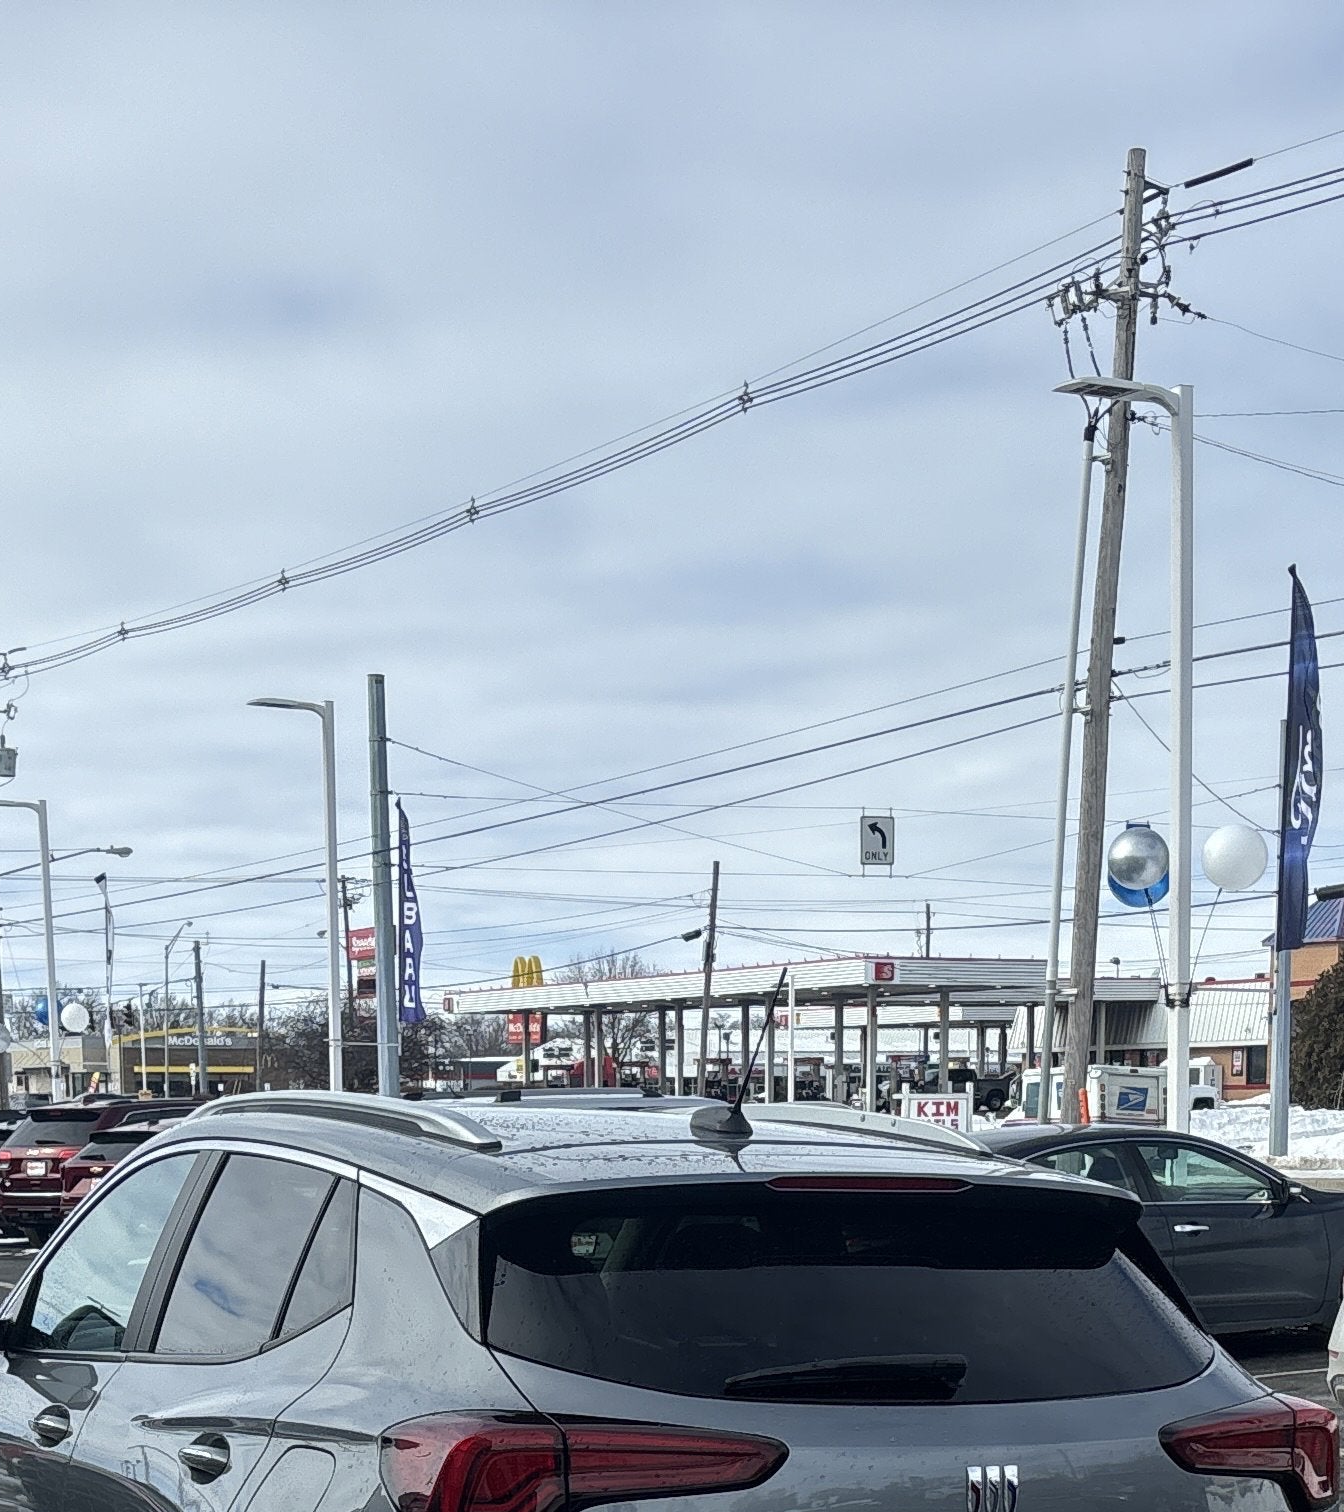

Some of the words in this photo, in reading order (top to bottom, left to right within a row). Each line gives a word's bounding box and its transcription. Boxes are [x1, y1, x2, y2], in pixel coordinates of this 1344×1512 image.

[864, 851, 889, 861] ONLY
[167, 1036, 233, 1047] McDoald's
[917, 1100, 960, 1118] KIM
